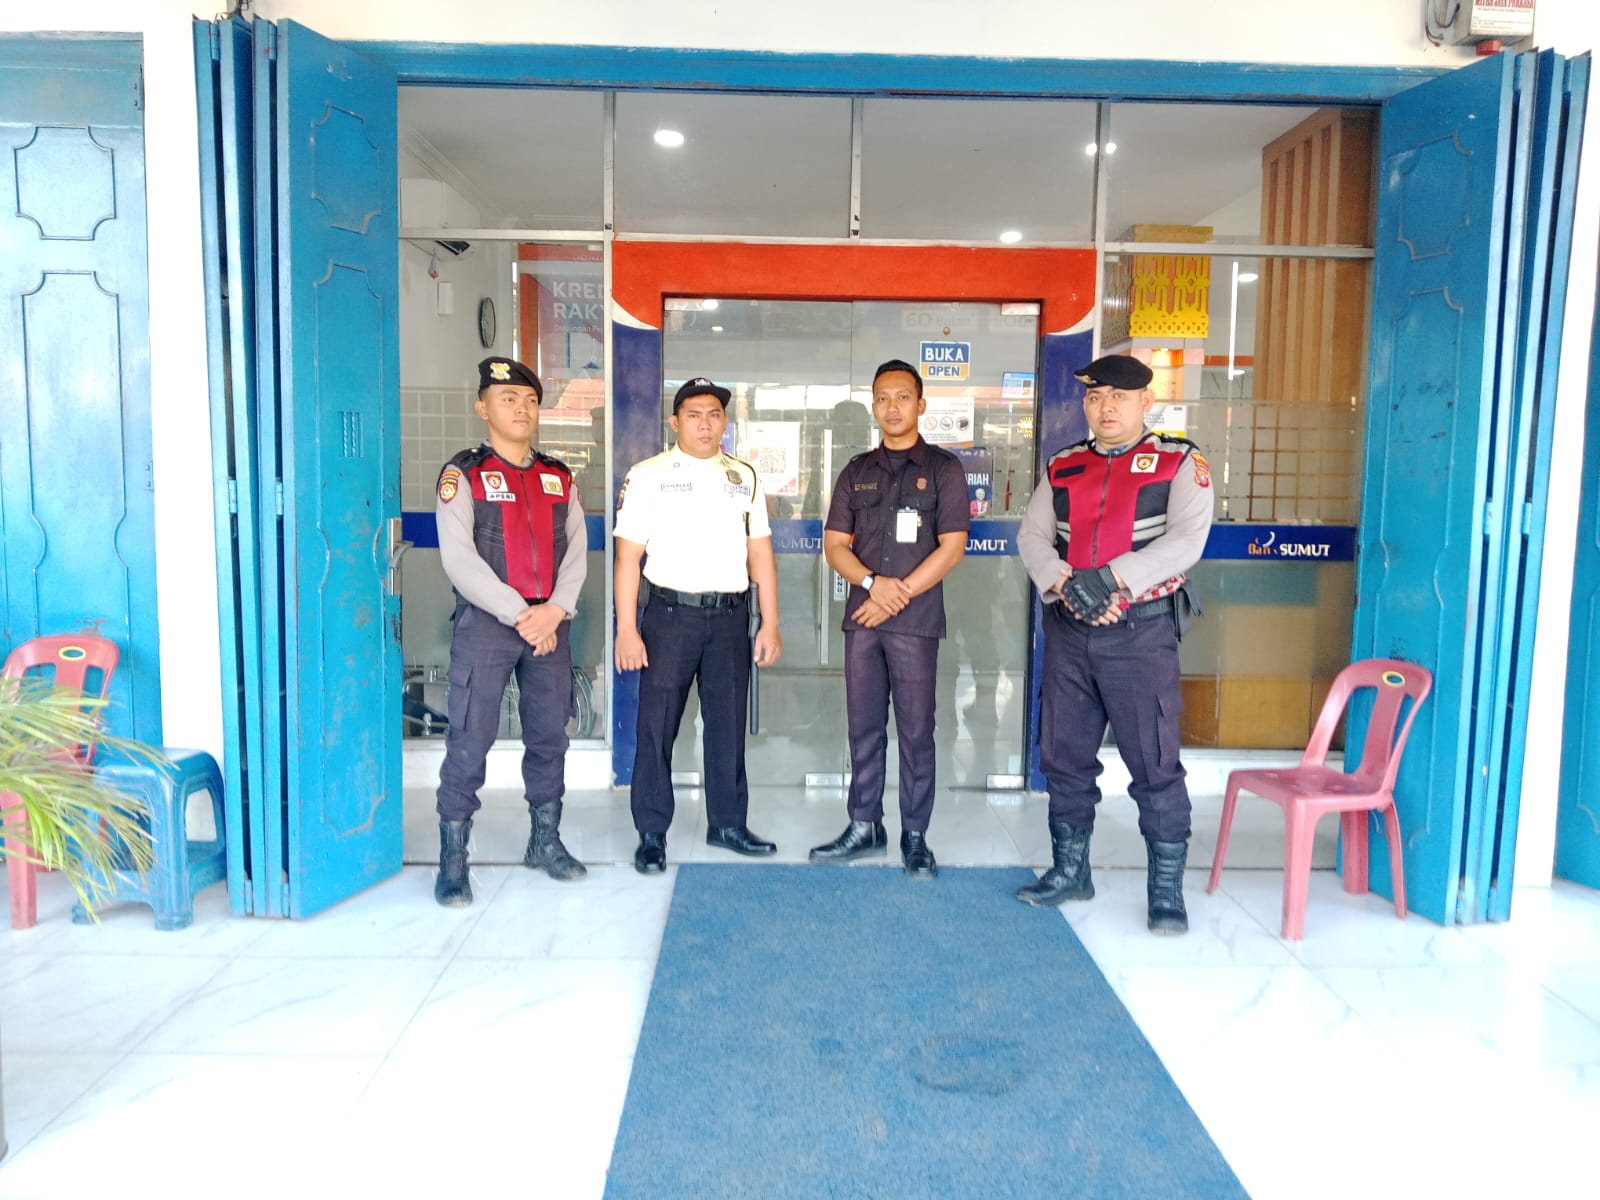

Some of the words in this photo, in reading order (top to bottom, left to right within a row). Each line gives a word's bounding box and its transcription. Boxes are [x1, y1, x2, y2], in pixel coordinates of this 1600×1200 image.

[924, 347, 964, 361] BUKA
[928, 365, 960, 377] OPEN
[965, 472, 990, 486] RIAH
[776, 537, 823, 549] UMUT
[965, 539, 1008, 551] UMUT
[1279, 543, 1330, 557] SUMUT
